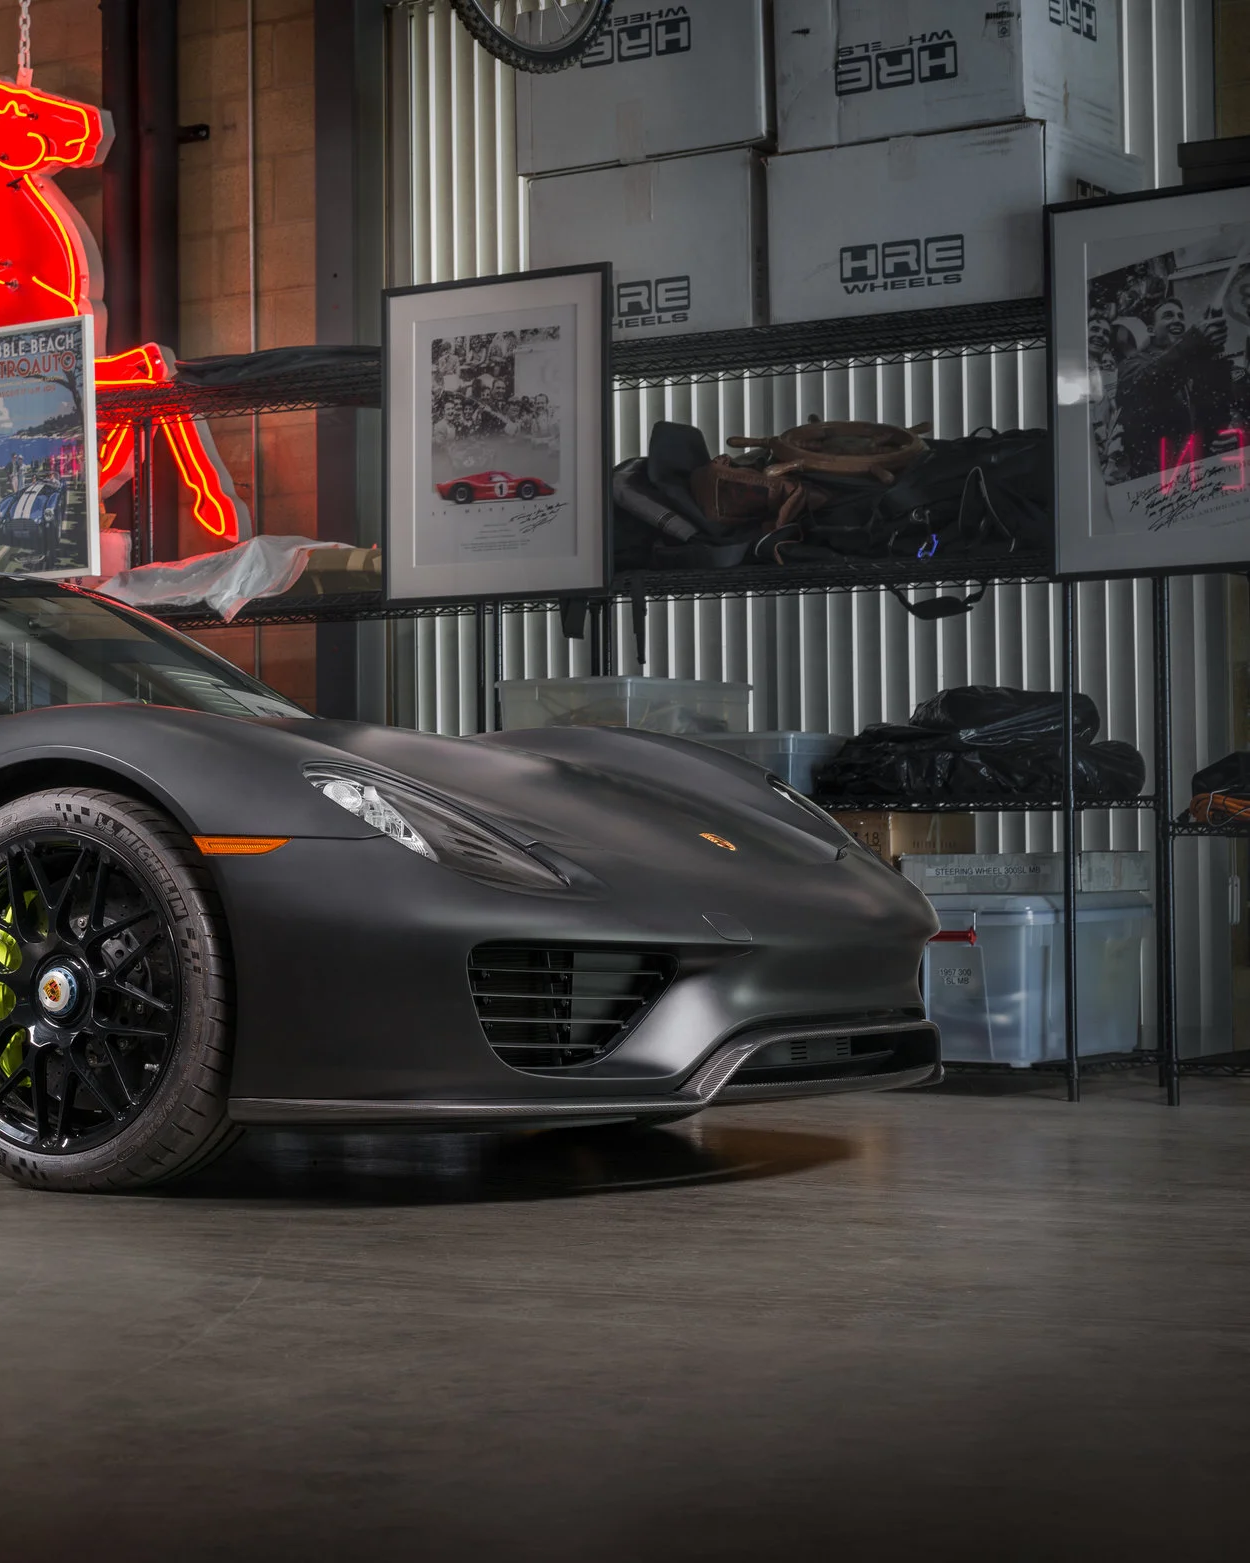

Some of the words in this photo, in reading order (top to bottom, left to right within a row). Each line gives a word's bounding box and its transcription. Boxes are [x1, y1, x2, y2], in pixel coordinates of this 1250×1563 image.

[835, 41, 958, 96] HRE
[840, 234, 964, 284] HRE
[843, 273, 962, 295] WHEELS
[613, 275, 690, 317] RE
[31, 333, 74, 354] BEACH
[114, 828, 189, 921] MICHELIN
[935, 867, 973, 876] STEERING
[975, 867, 1002, 875] WHEEL
[1004, 866, 1027, 875] 300SL
[1029, 866, 1041, 874] MB
[940, 968, 956, 976] 1957
[958, 968, 972, 976] 300
[945, 977, 956, 985] SL
[957, 977, 969, 985] MB
